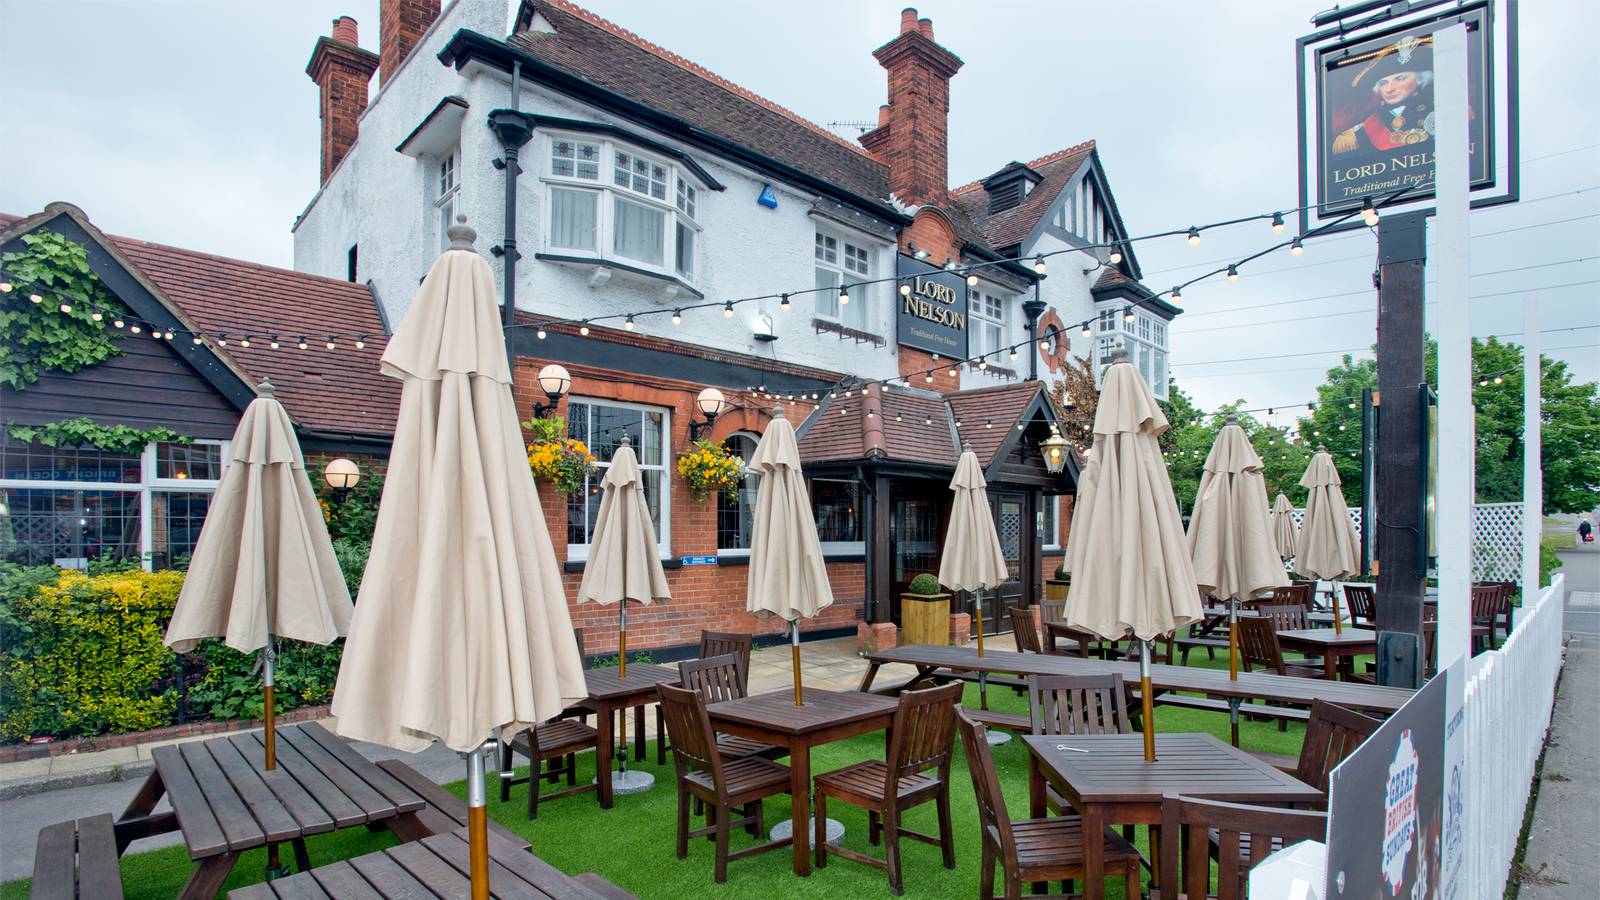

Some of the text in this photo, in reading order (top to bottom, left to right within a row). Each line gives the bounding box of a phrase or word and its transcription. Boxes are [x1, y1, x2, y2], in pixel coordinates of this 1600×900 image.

[1334, 163, 1386, 183] LORD
[1343, 177, 1399, 196] Traditional
[1403, 173, 1425, 185] Free
[914, 276, 956, 304] LORD
[904, 293, 965, 329] NELSON
[911, 327, 934, 340] Traditional
[1389, 763, 1415, 807] GREAT
[1387, 795, 1412, 837] BRITISH
[1386, 821, 1411, 866] SUNDAYS
